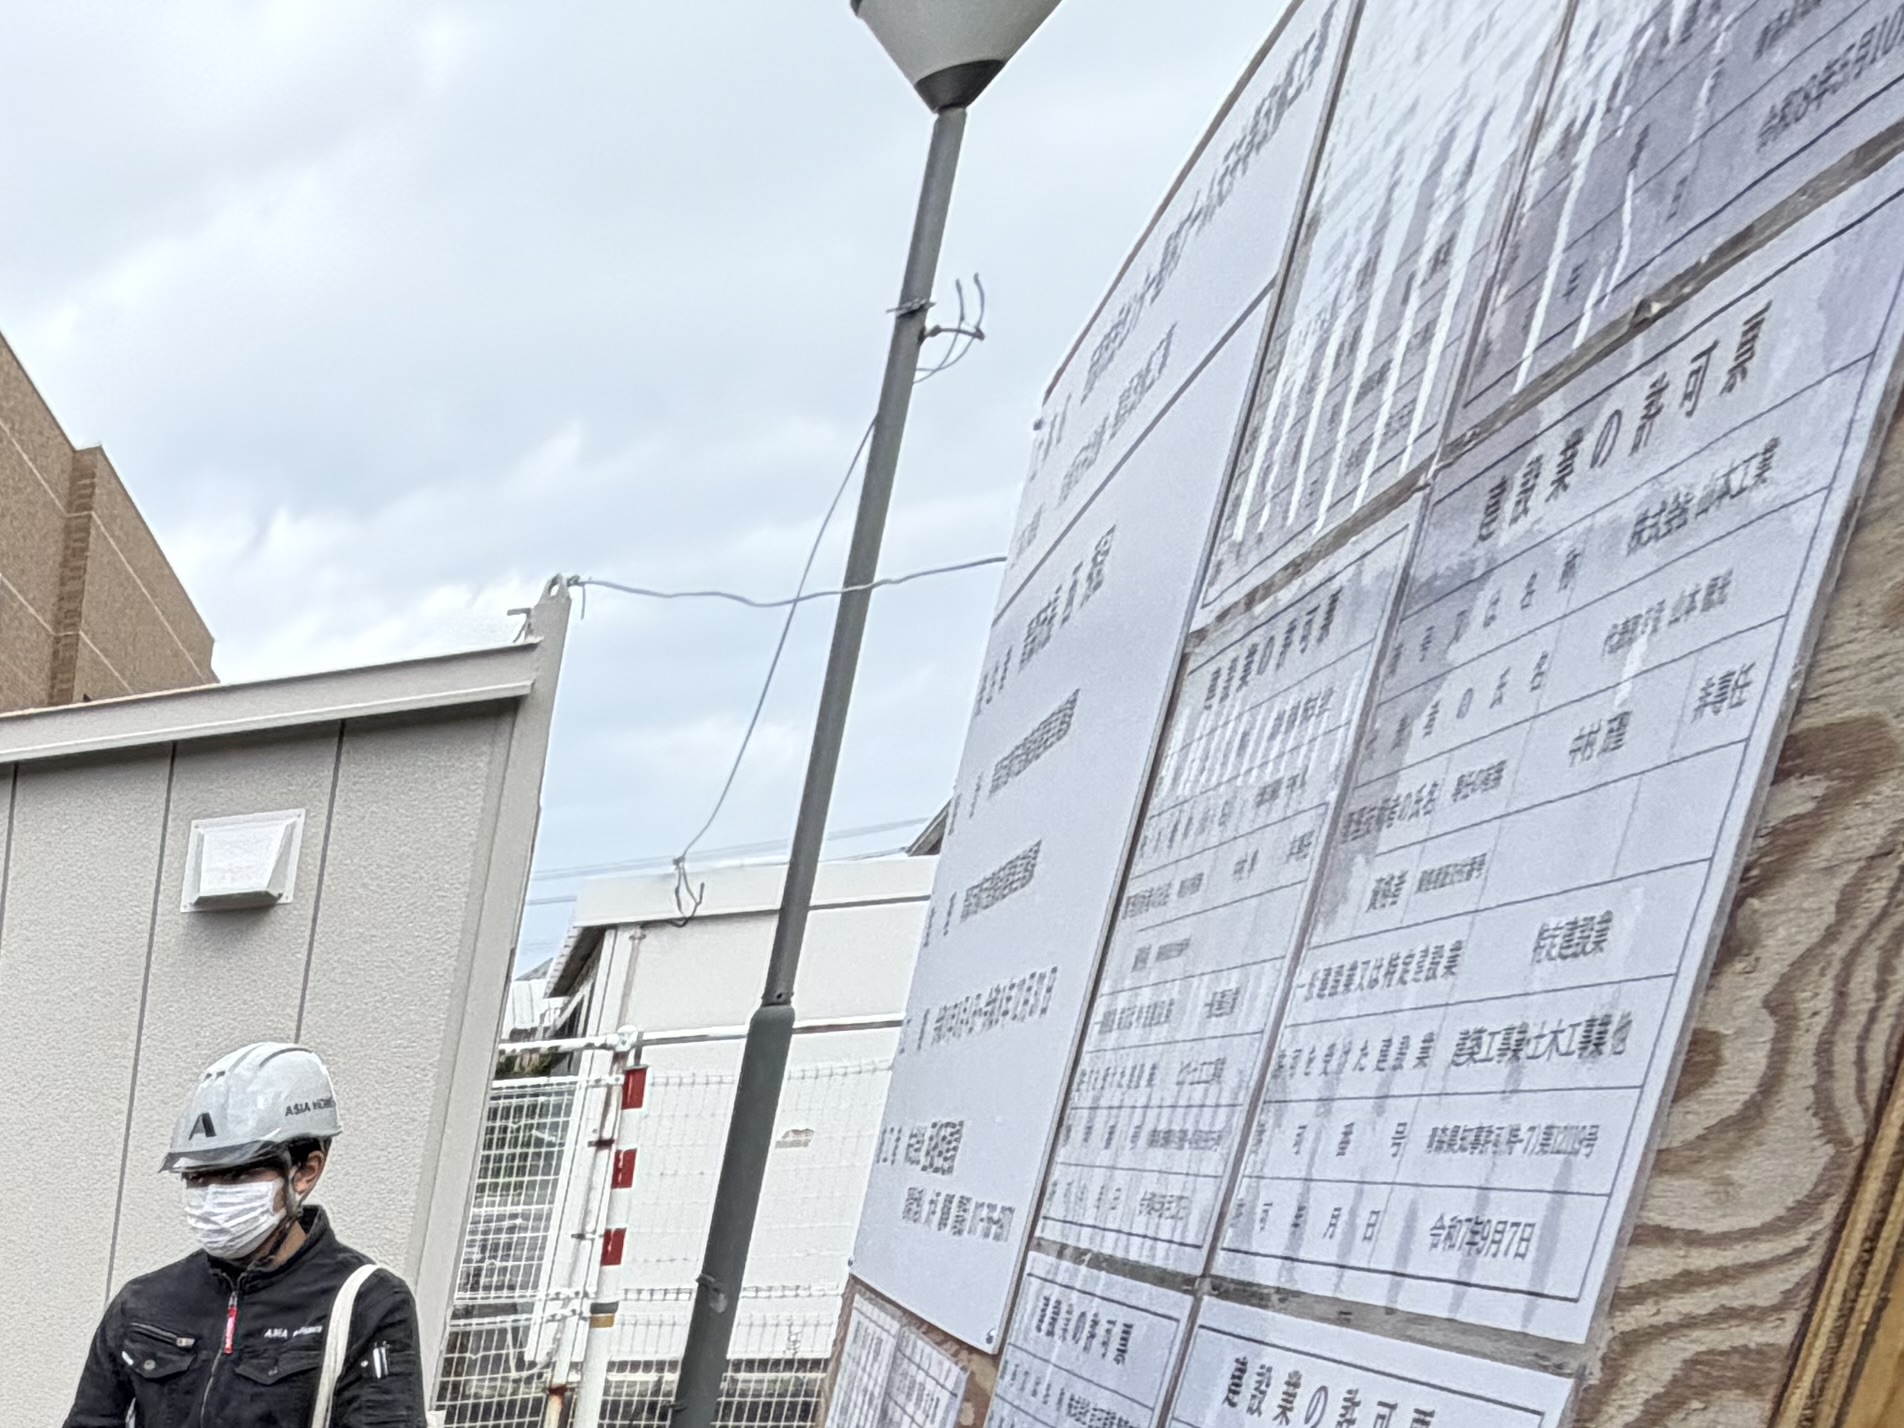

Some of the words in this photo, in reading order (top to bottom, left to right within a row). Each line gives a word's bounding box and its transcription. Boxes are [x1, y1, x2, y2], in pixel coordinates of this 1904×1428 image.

[1476, 303, 1770, 542] 建設業の許可票
[1427, 1214, 1535, 1259] 令和7年9月7日
